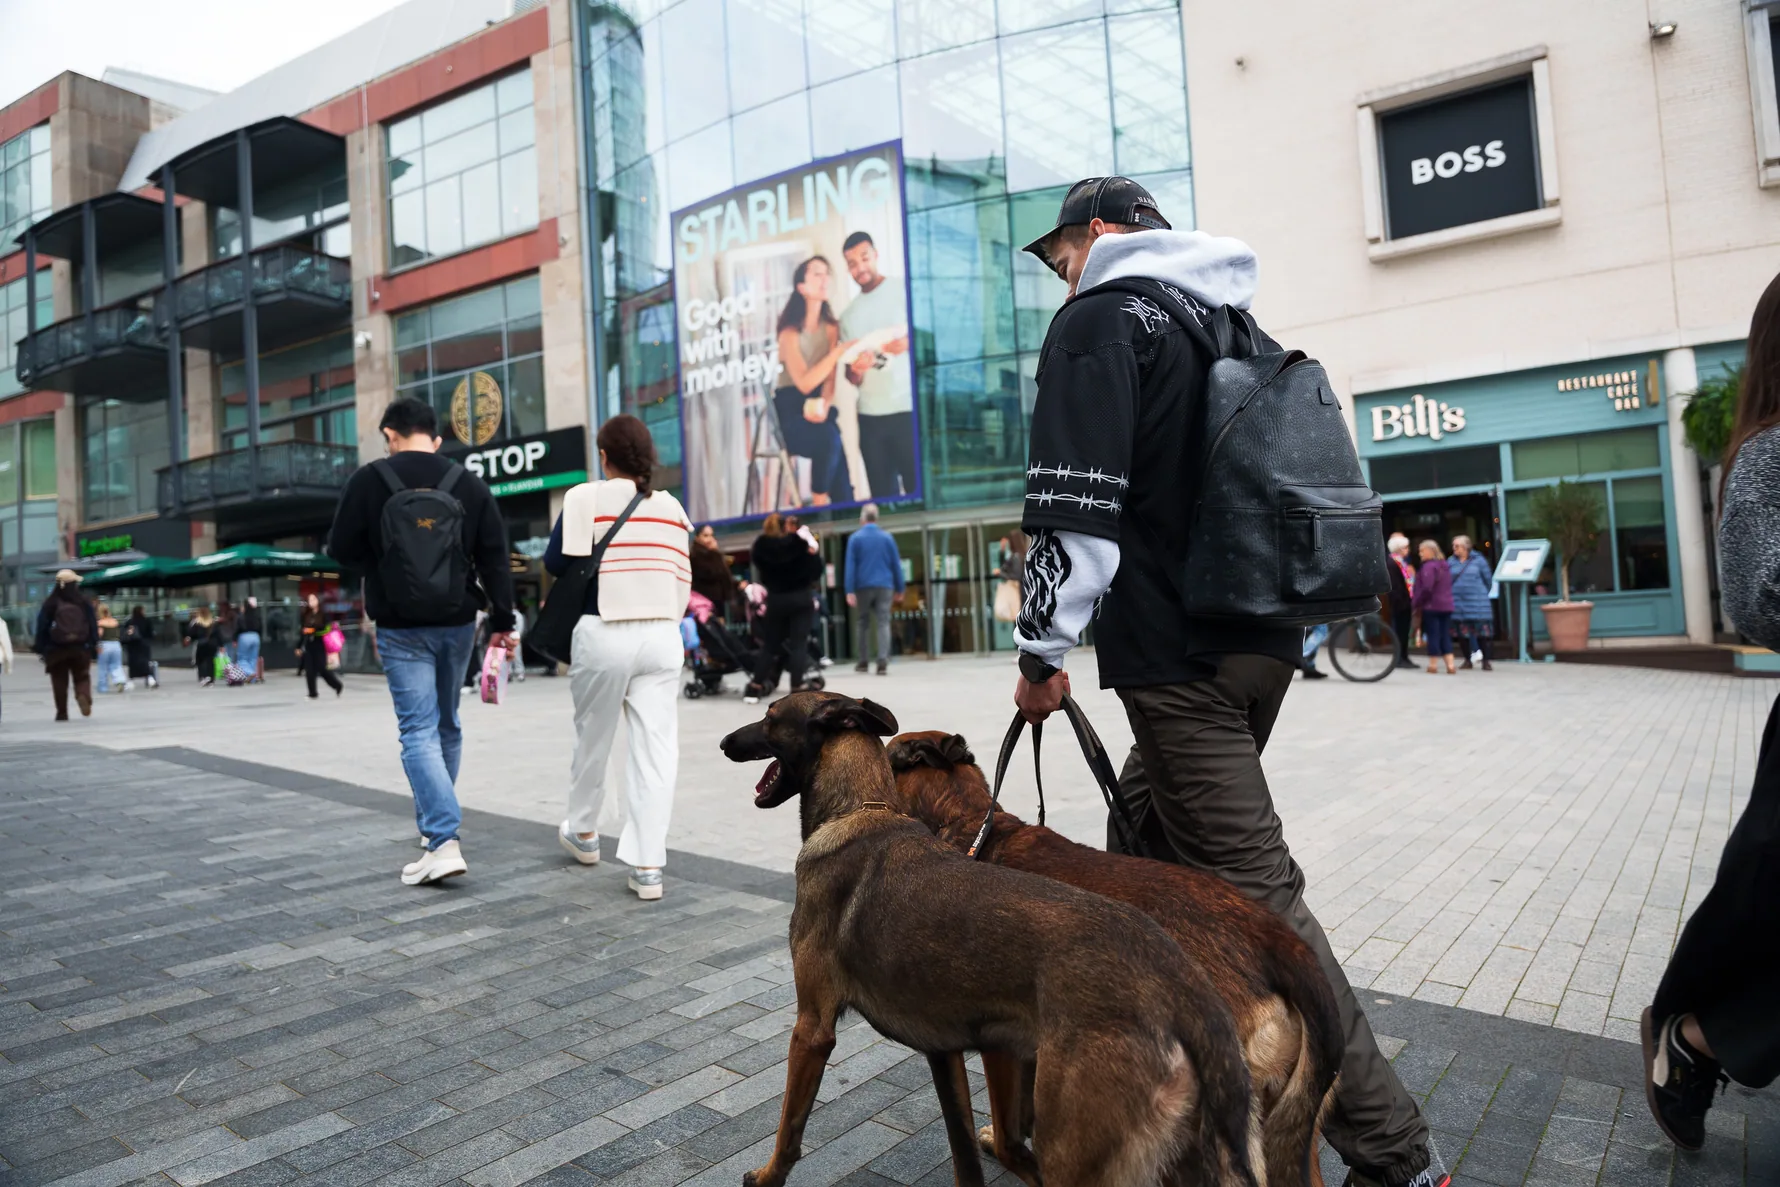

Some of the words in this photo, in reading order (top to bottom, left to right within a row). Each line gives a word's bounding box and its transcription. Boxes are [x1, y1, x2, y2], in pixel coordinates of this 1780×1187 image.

[1411, 140, 1506, 185] BOSS
[680, 157, 893, 264] STARLING
[684, 281, 756, 331] Good
[684, 322, 740, 364] with
[686, 350, 784, 395] money.
[1557, 369, 1637, 392] RESTAURANT
[1371, 394, 1467, 441] Bill's
[1615, 396, 1640, 411] BAR
[464, 441, 546, 479] STOP
